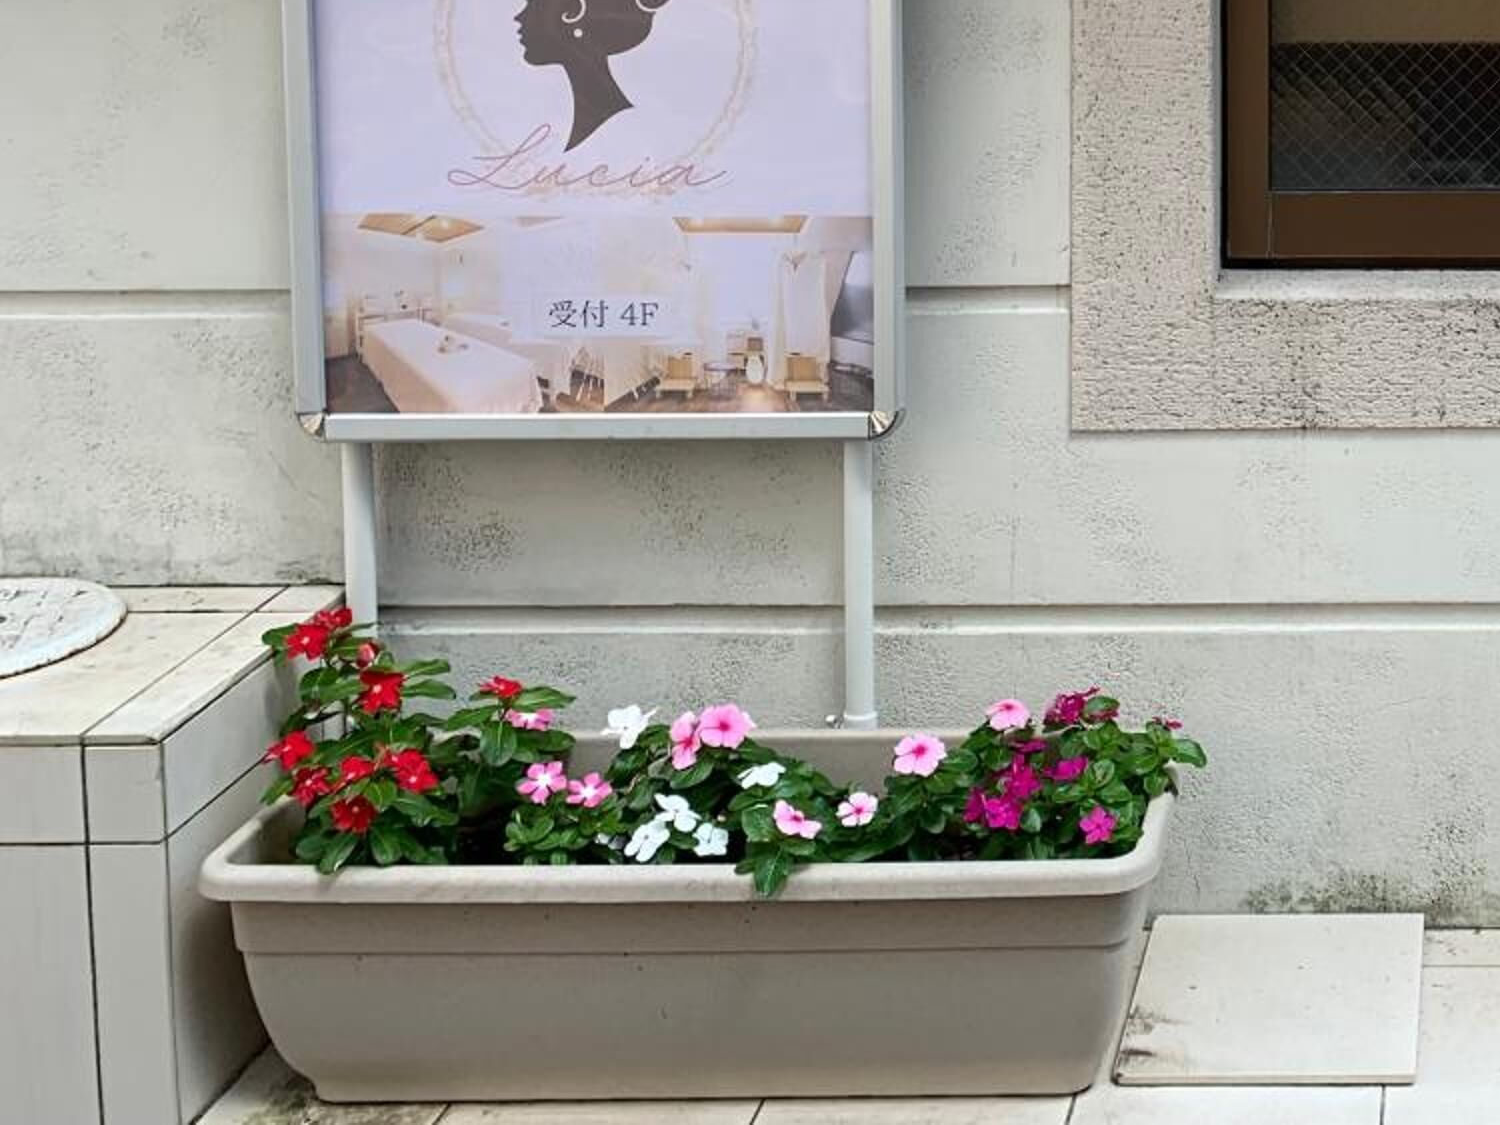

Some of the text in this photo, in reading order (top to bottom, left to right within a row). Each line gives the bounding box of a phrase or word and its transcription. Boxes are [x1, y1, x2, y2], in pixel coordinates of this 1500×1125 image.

[447, 123, 728, 190] Lucia
[548, 299, 660, 329] 受付 4F
